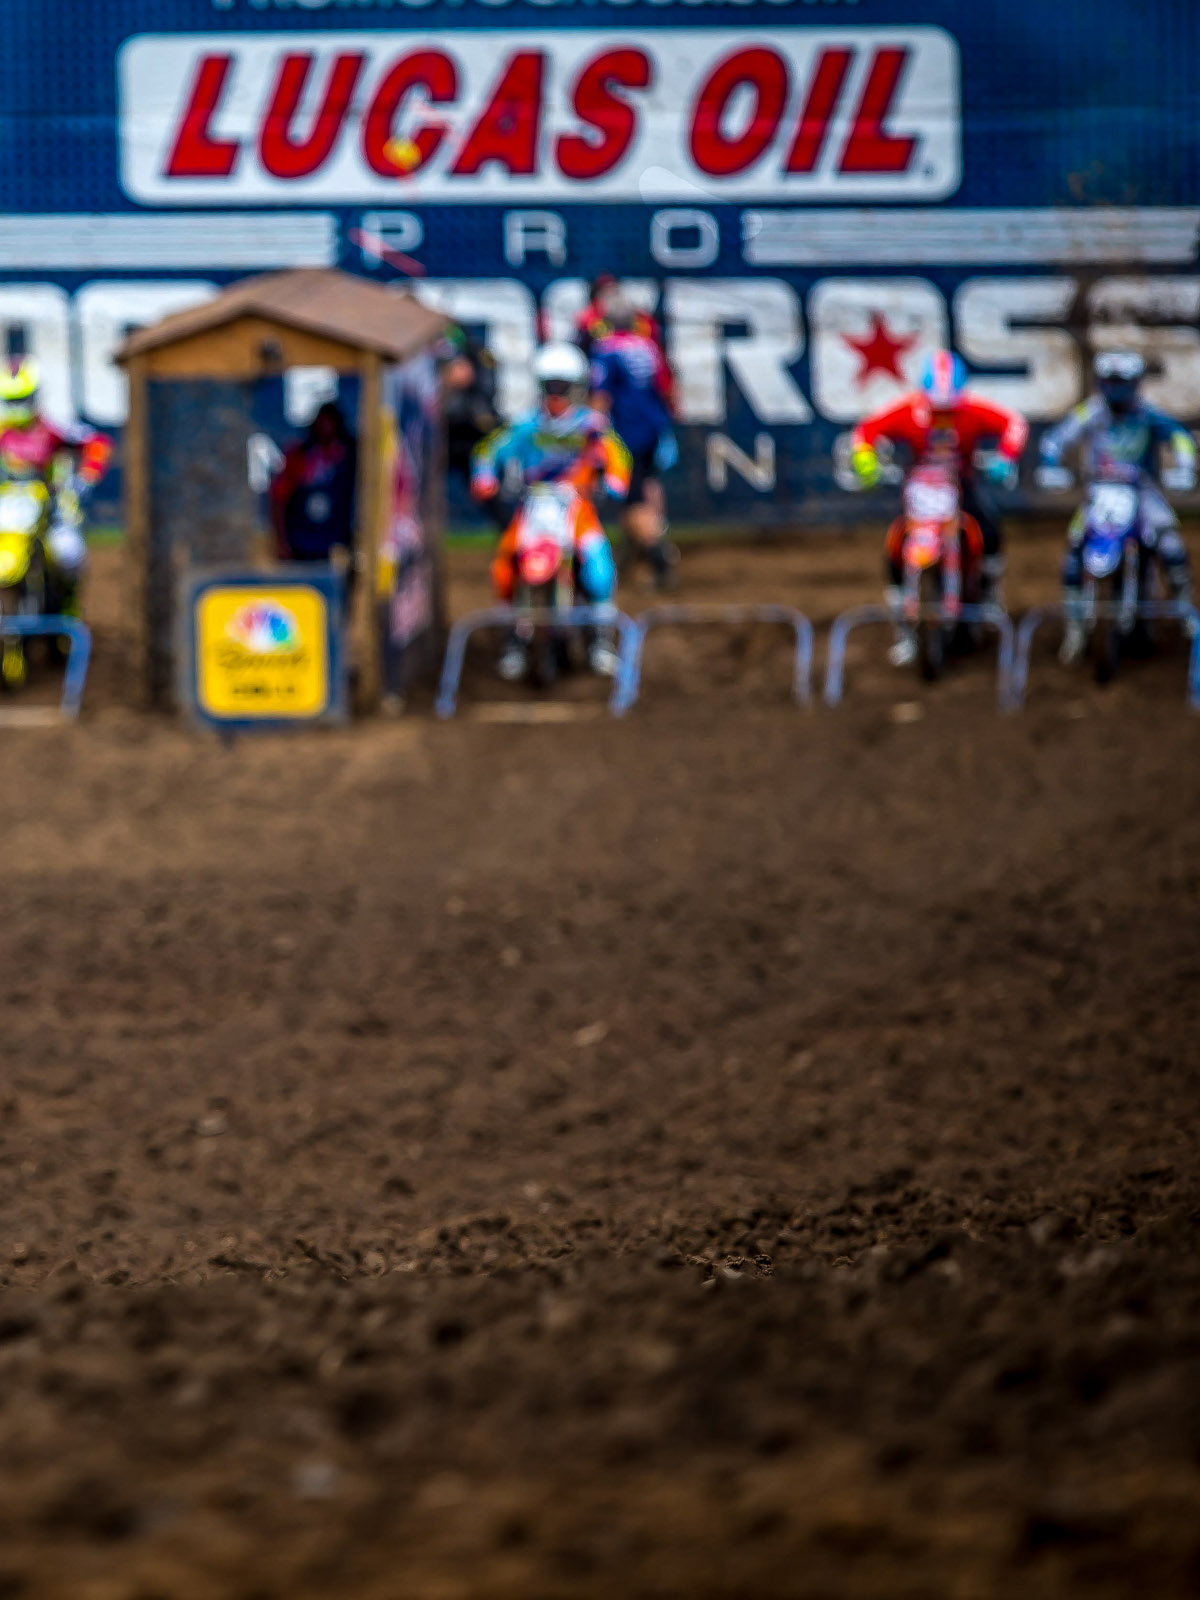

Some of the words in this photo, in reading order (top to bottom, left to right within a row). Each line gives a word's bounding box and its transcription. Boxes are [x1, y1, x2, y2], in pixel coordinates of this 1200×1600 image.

[164, 46, 654, 180] LUCAS
[689, 46, 921, 177] OIL
[357, 209, 720, 268] PRO
